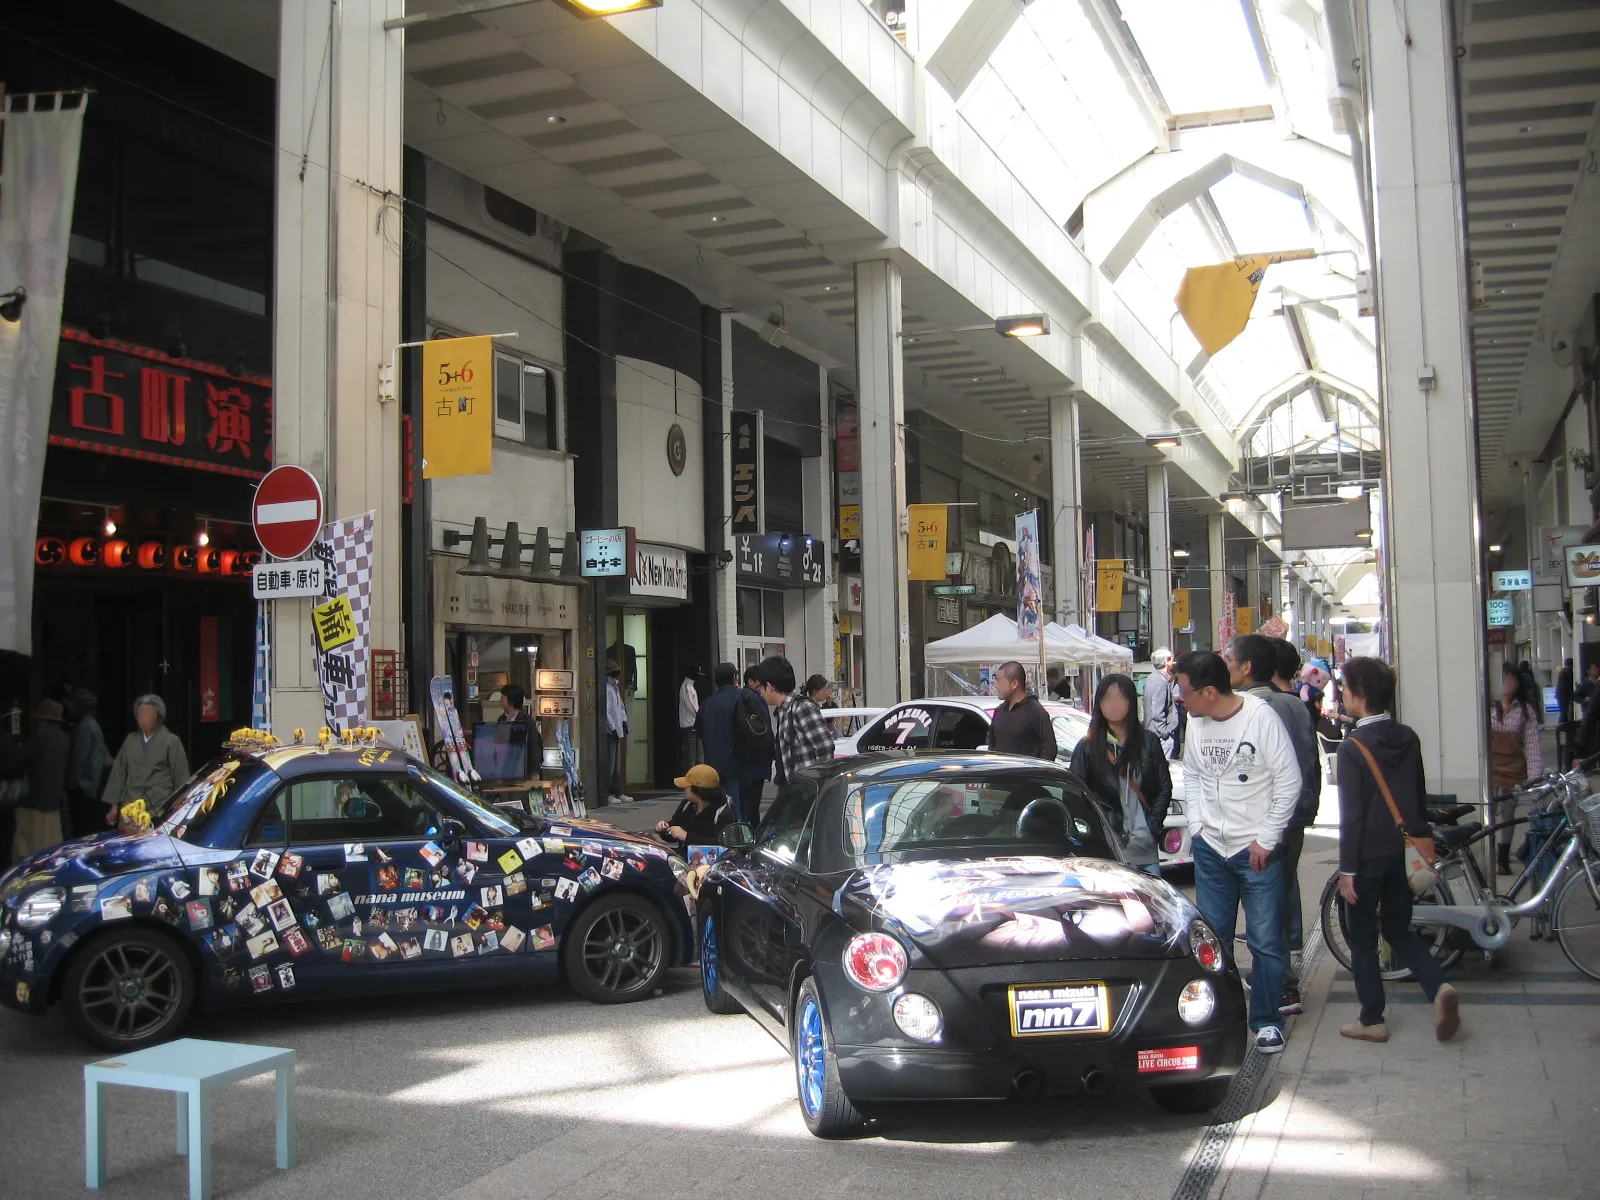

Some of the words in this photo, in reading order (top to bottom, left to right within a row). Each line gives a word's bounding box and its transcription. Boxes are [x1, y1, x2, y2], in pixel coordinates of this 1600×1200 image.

[438, 360, 474, 385] 5+6
[69, 355, 273, 461] 古町演
[918, 521, 938, 533] 5+6
[586, 557, 621, 568] 白十字
[754, 553, 763, 573] 1F
[812, 563, 822, 583] 2F
[884, 708, 932, 729] MIZUKI
[895, 722, 916, 744] 7
[354, 892, 397, 905] nana
[400, 890, 466, 903] museum
[1018, 990, 1051, 1001] nana
[1053, 985, 1096, 999] mizuki
[1022, 1001, 1096, 1028] nm7
[1138, 1059, 1155, 1069] LIVE
[1156, 1057, 1181, 1067] CIRCUS
